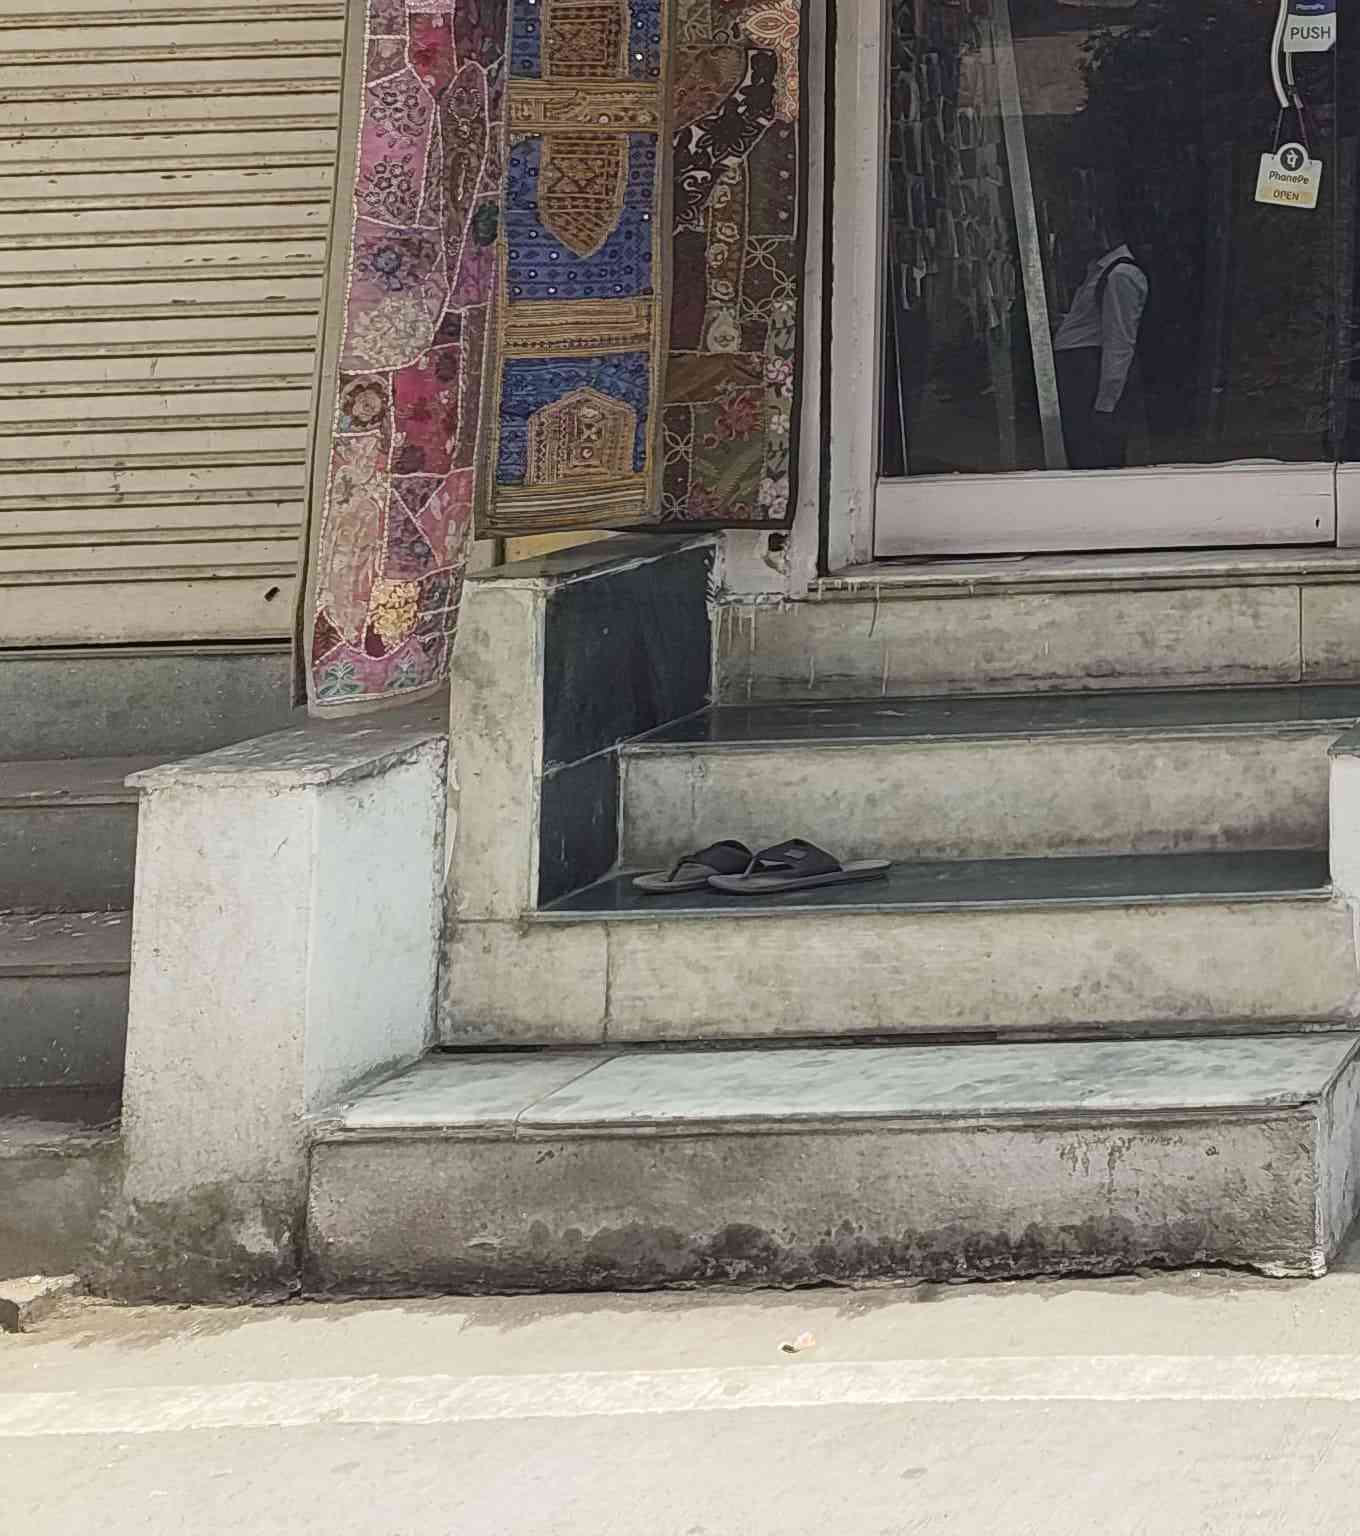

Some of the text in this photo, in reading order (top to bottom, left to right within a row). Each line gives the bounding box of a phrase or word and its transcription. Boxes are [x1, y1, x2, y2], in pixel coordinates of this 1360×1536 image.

[1289, 25, 1331, 41] PUSH
[1268, 169, 1310, 186] PhonePe
[1273, 190, 1301, 202] OPEN
